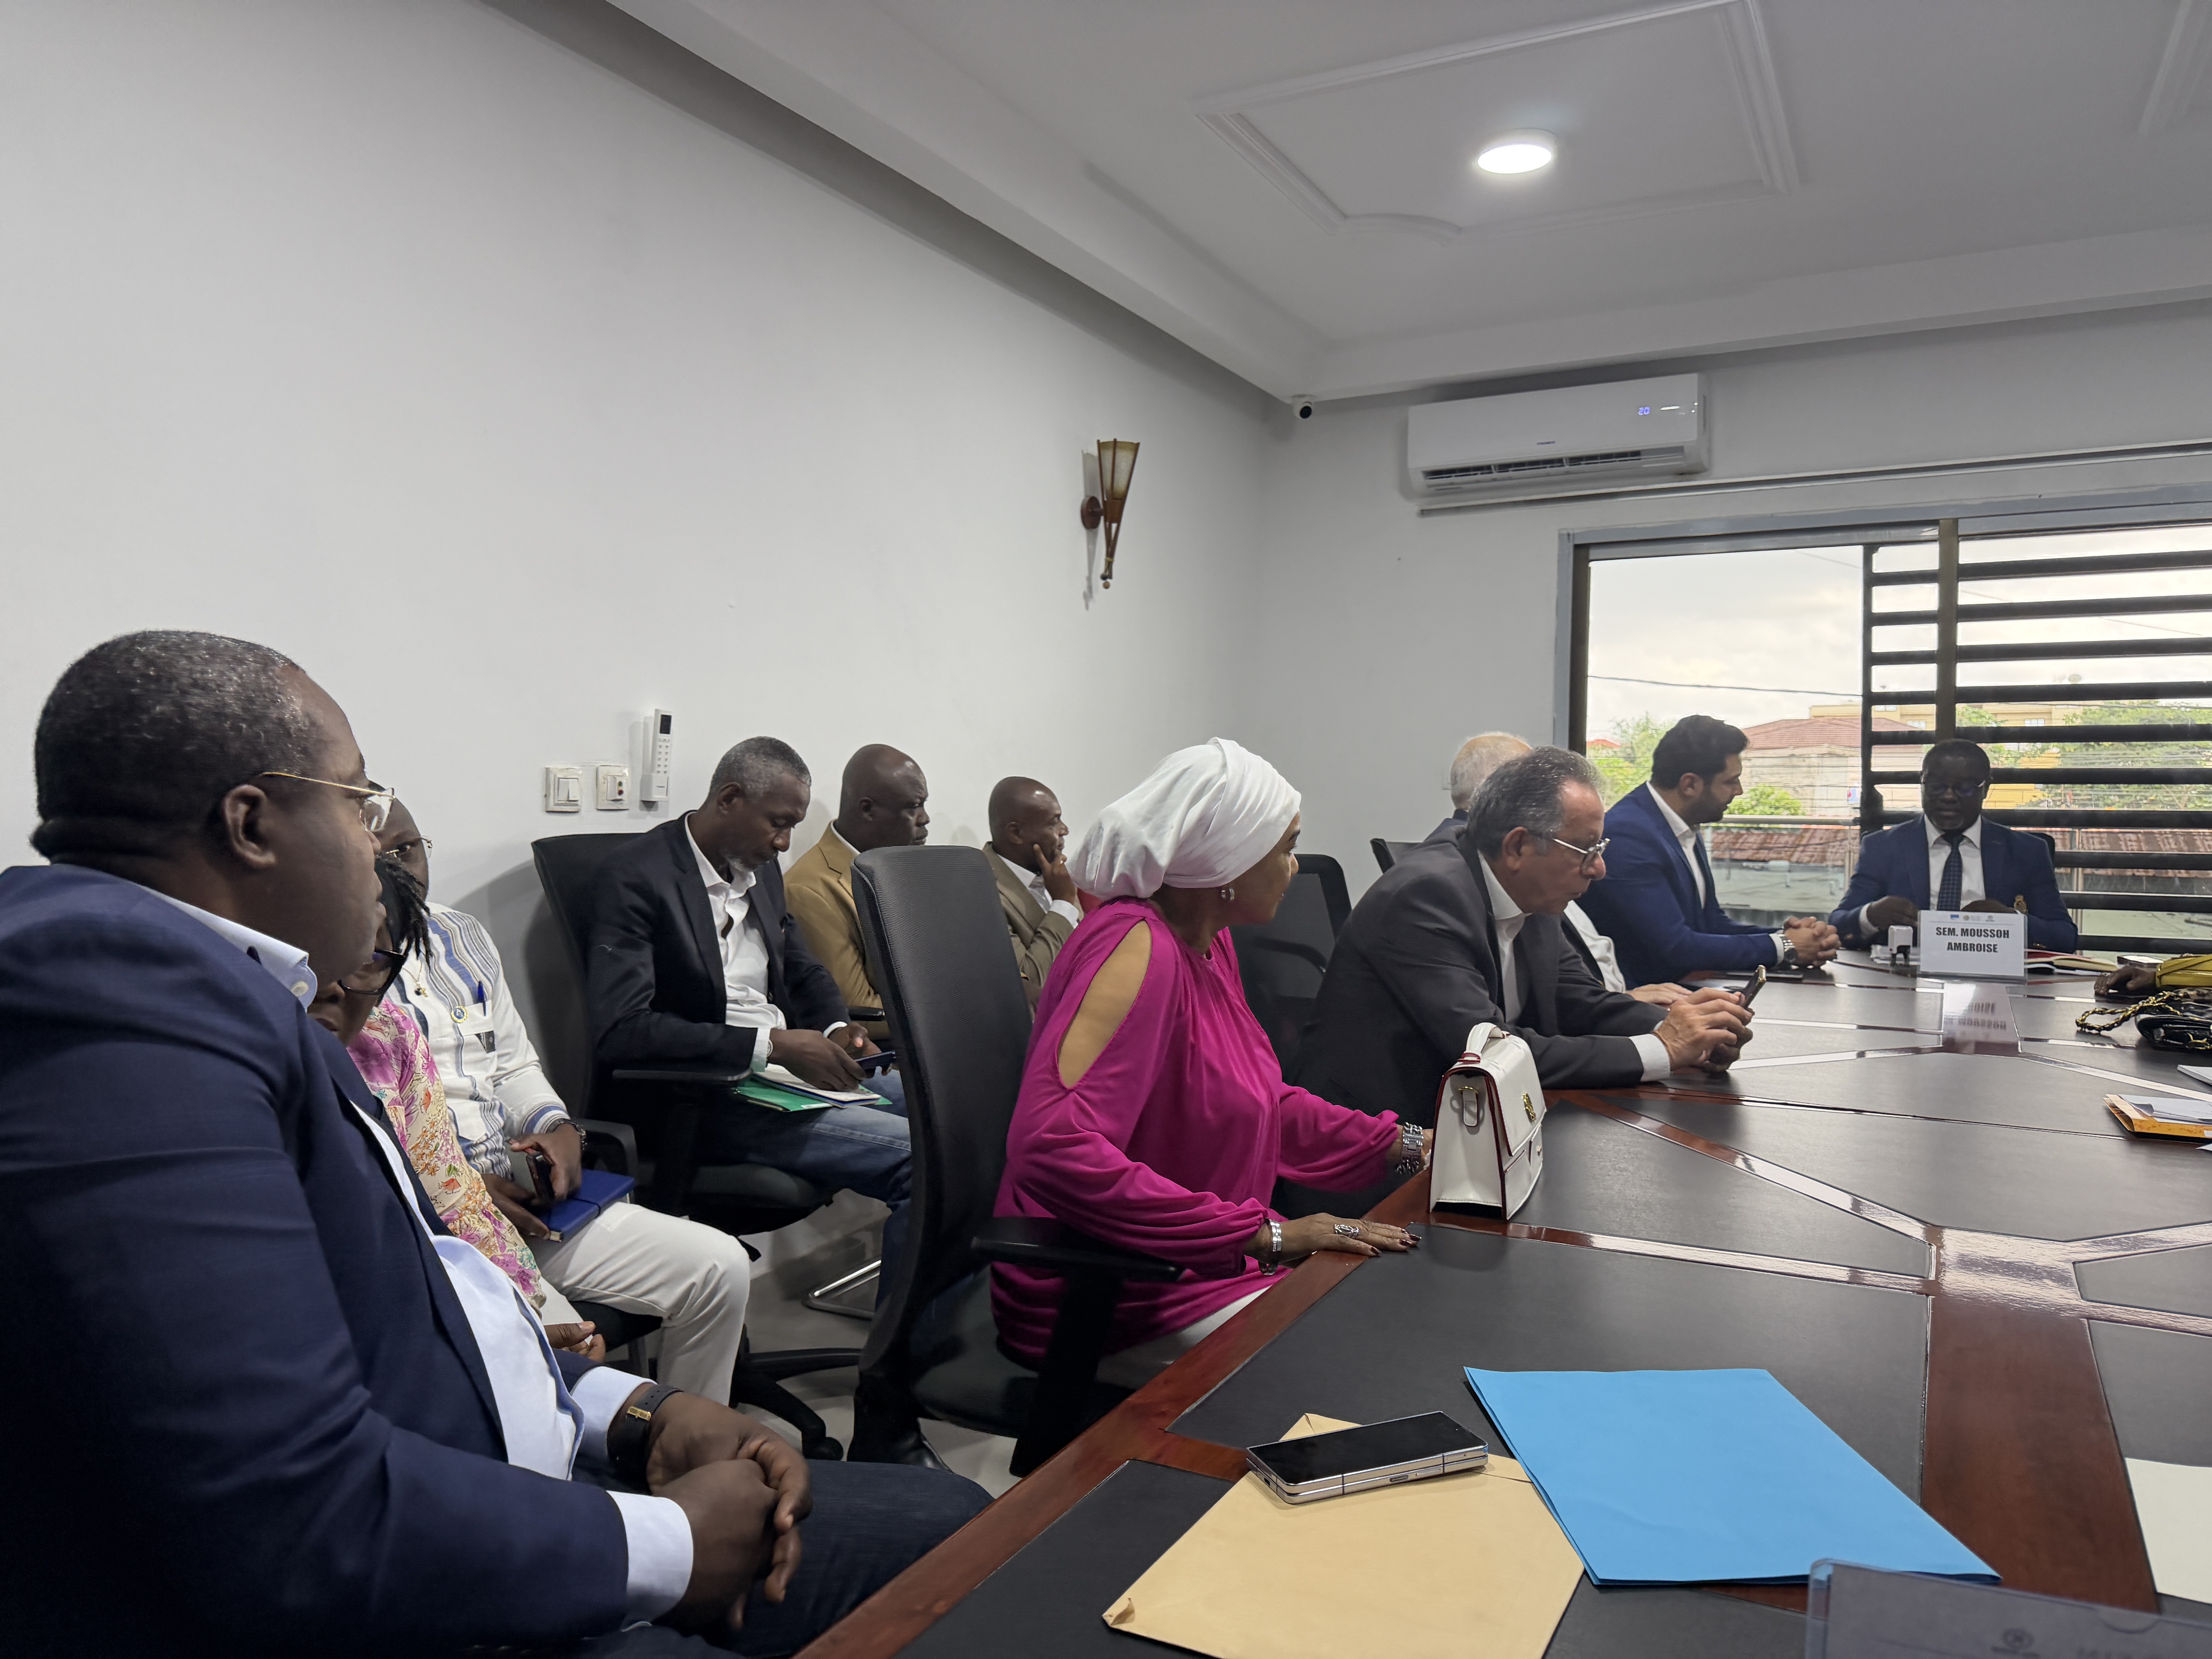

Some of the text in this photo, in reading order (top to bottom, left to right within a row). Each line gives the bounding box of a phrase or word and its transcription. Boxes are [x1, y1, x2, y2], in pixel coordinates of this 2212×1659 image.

[1638, 407, 1650, 415] 20
[1936, 927, 2009, 938] SEM. MOUSSOH
[1947, 942, 1997, 953] AMBROISE
